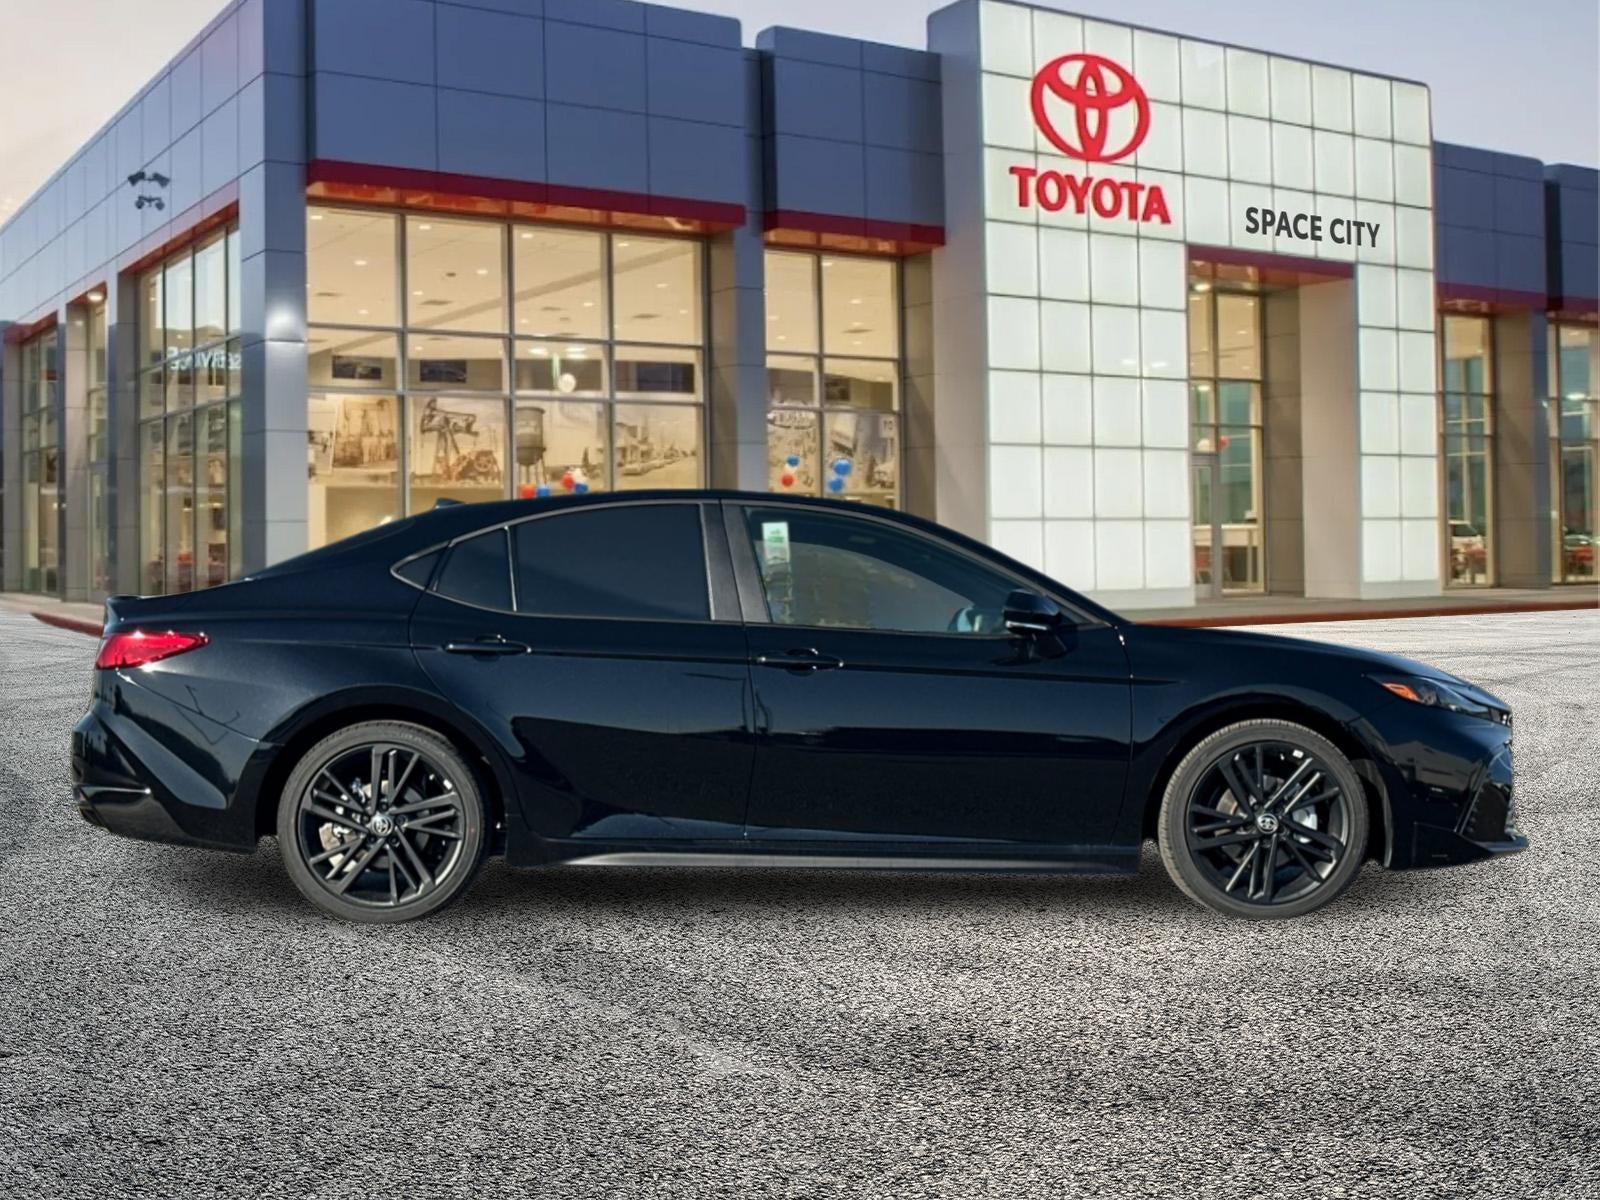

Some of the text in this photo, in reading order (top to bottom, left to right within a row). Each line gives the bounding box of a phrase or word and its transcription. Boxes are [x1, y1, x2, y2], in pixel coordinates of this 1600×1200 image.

[1009, 166, 1171, 224] TOYOTA
[1245, 206, 1380, 248] SPACE CITY
